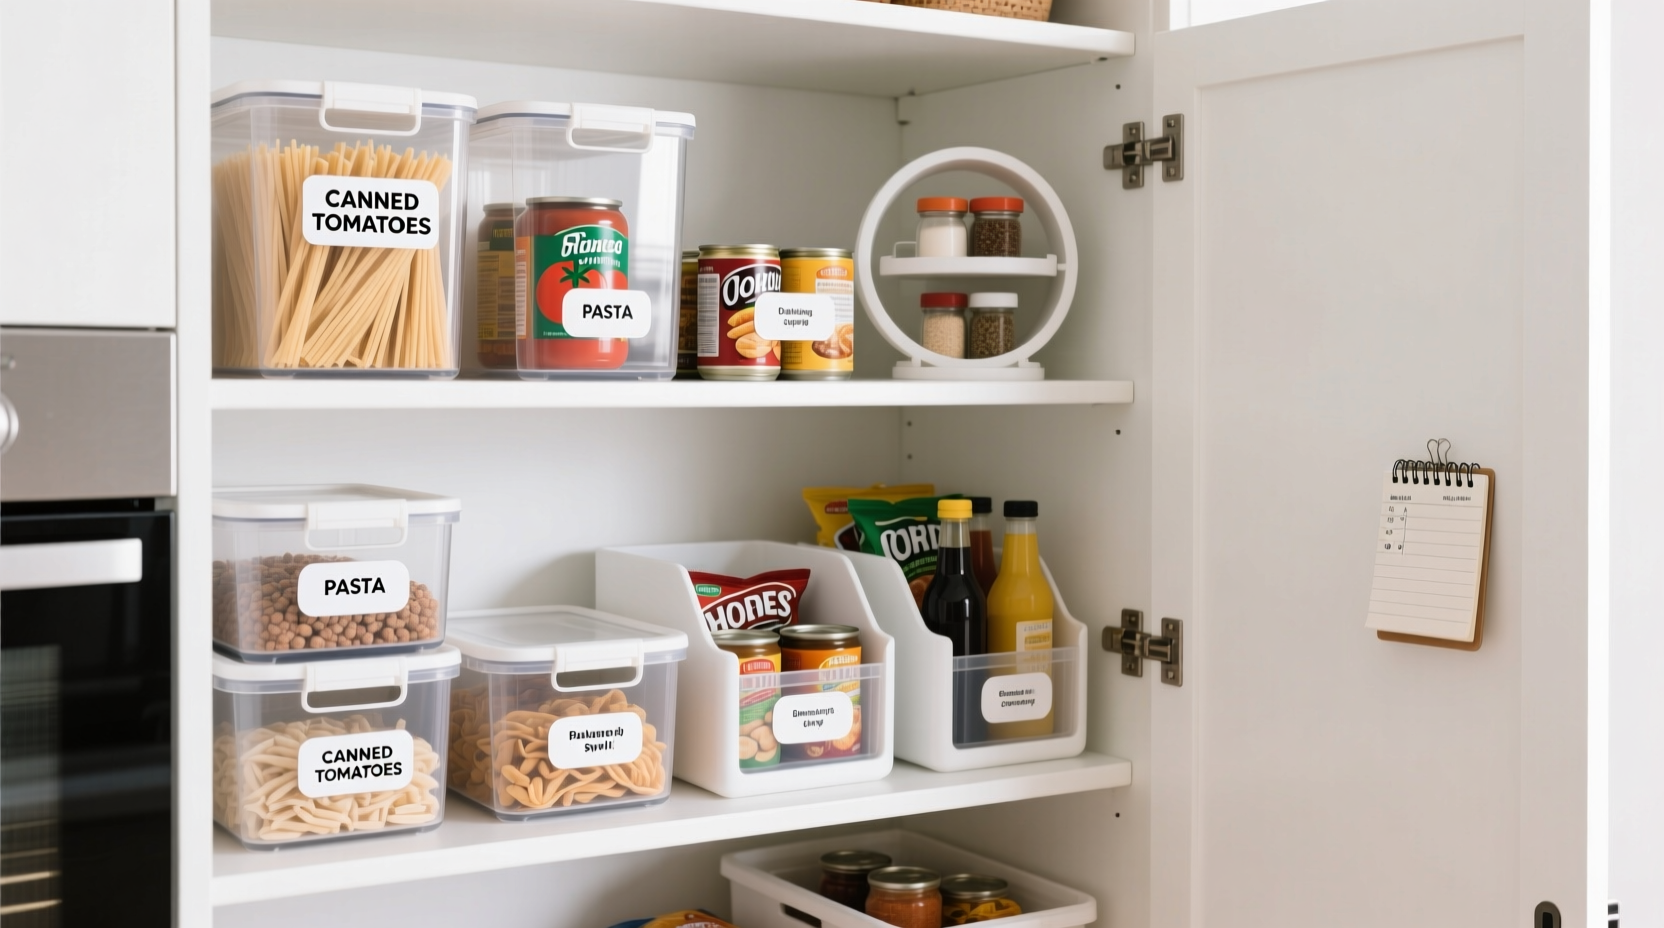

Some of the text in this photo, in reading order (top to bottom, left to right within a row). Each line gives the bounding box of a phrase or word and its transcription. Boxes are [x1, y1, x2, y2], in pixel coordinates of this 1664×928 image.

[325, 189, 421, 211] CANNED
[311, 212, 432, 236] TOMATOES
[582, 303, 634, 320] PASTA
[324, 577, 386, 596] PASTA
[321, 745, 393, 764] CANNED
[314, 761, 403, 783] TOMATOES
